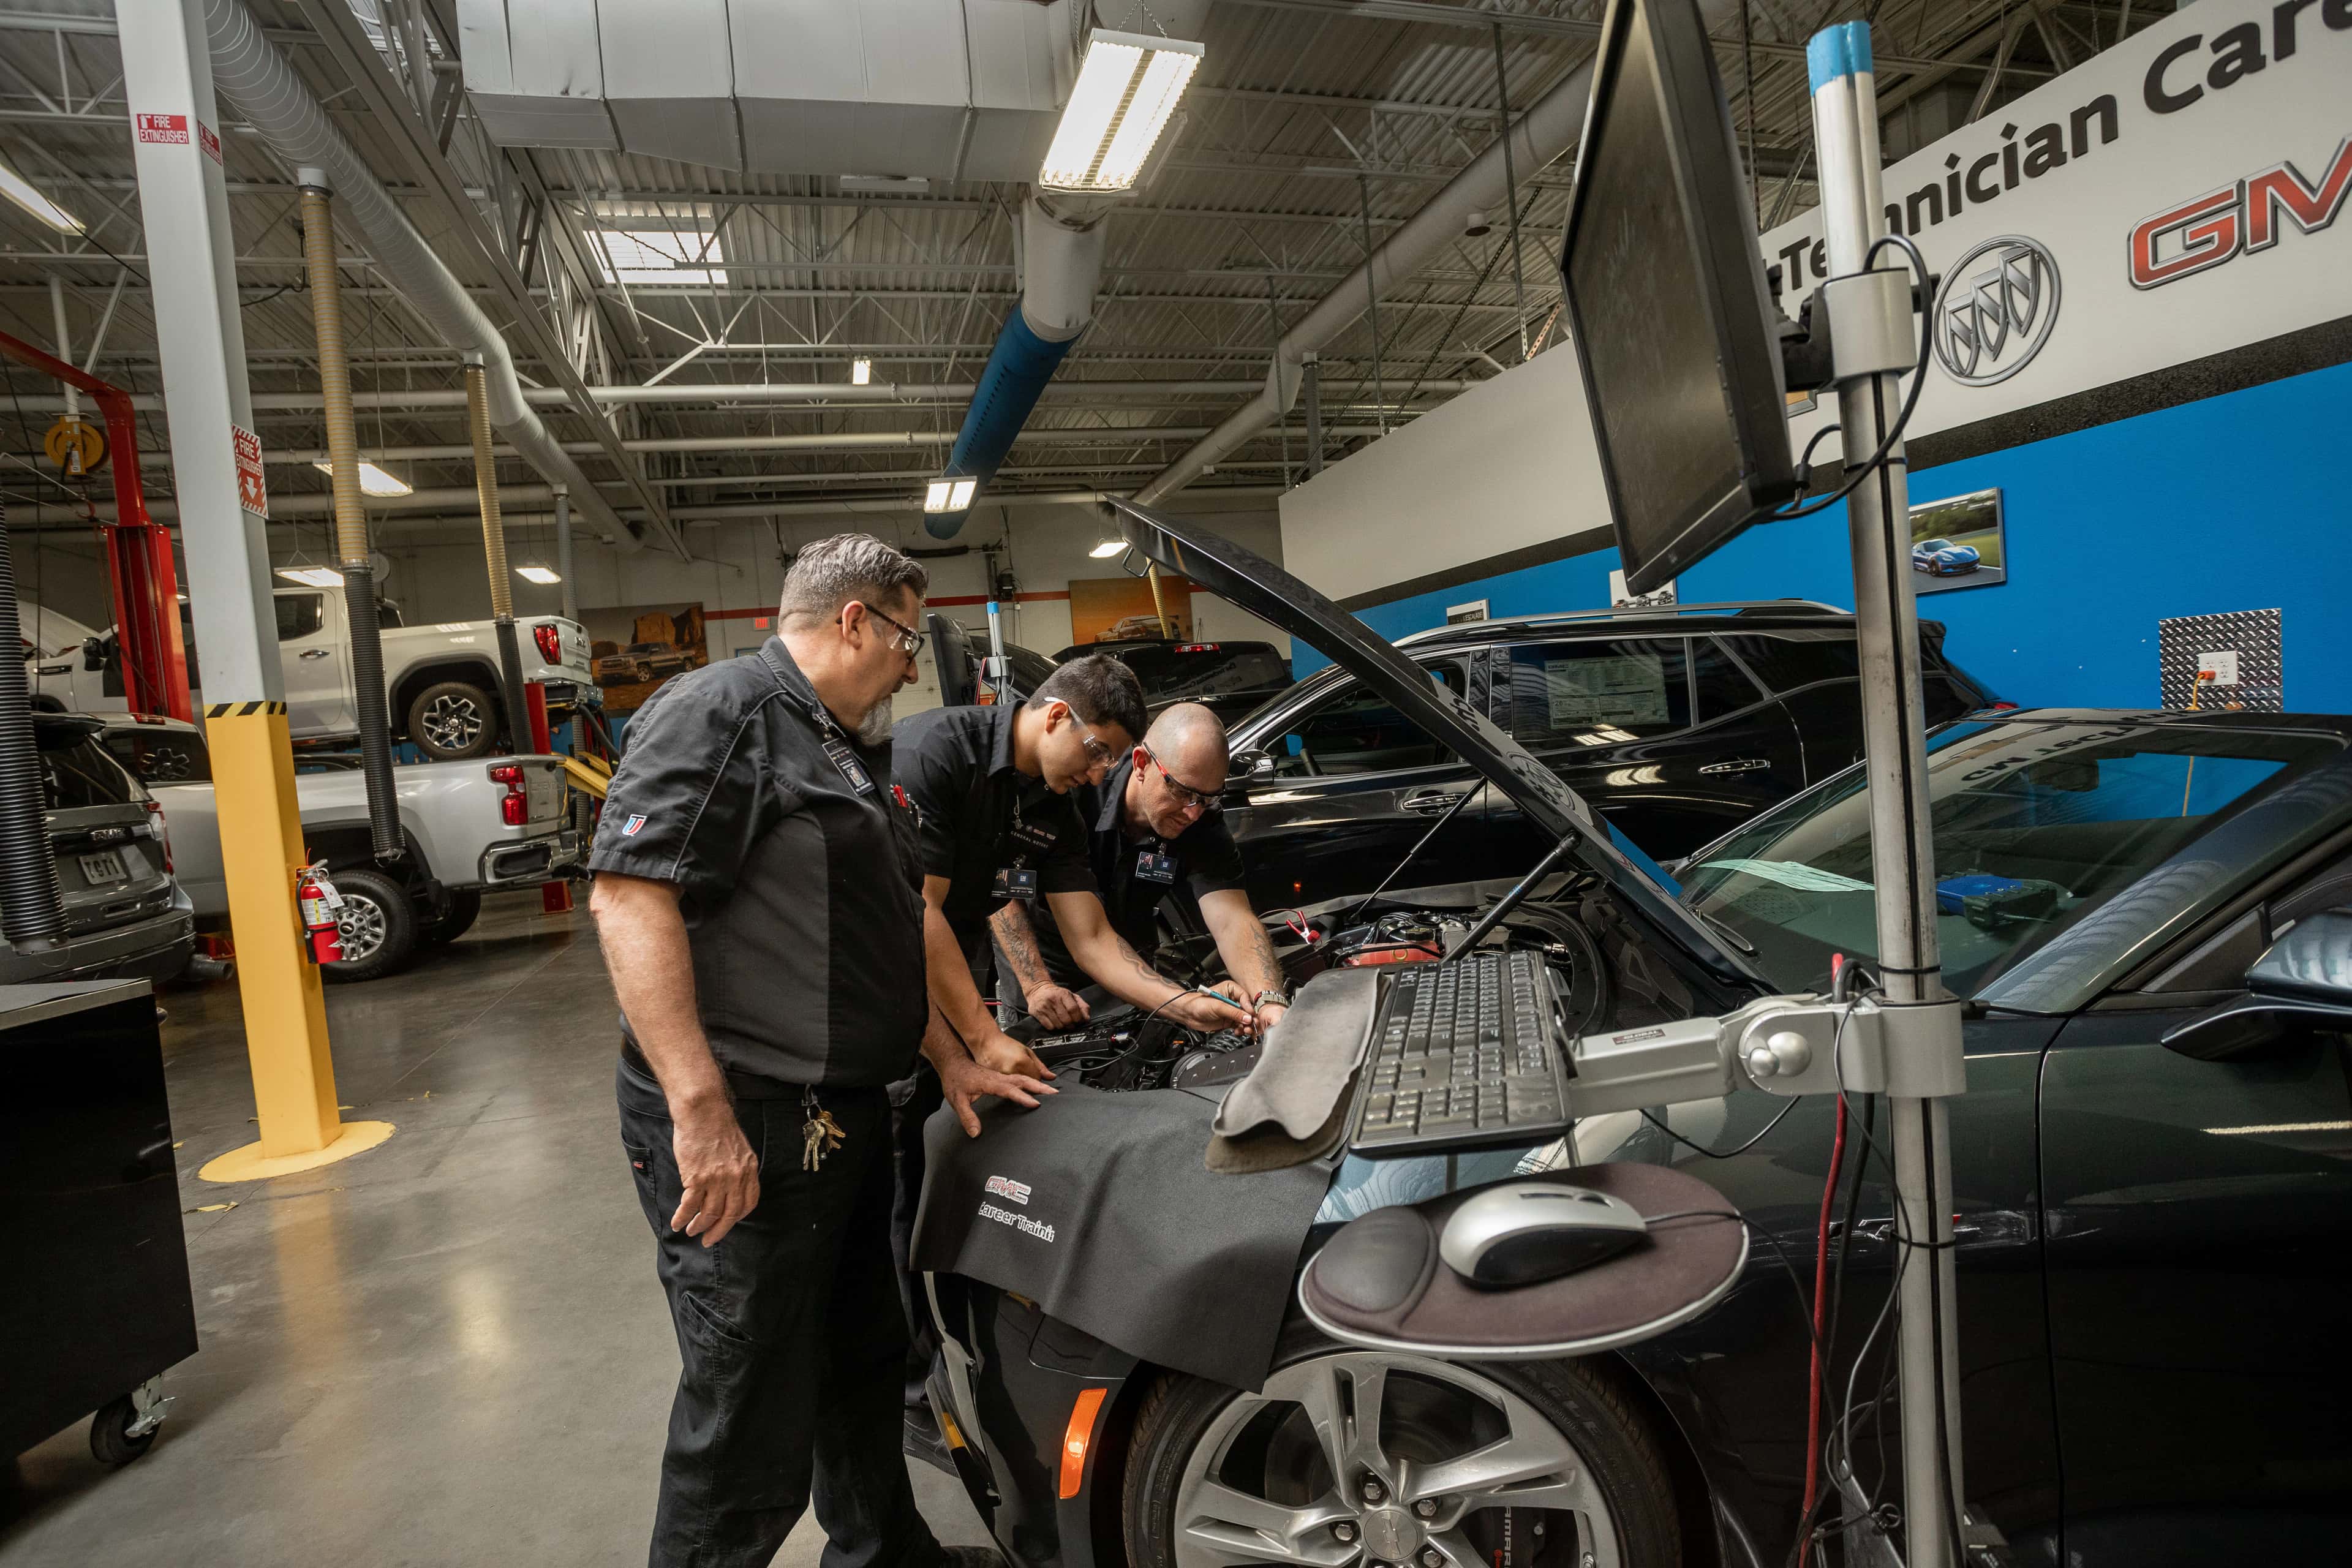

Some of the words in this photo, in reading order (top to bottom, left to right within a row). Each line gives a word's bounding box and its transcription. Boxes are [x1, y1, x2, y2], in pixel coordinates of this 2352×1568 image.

[153, 115, 171, 129] FIRE
[140, 129, 189, 144] EXTINGUISHER
[1779, 94, 2118, 290] Tenician
[239, 438, 255, 459] FIRE
[236, 453, 262, 477] EXTINGUISHER
[984, 1175, 1031, 1205] GMC
